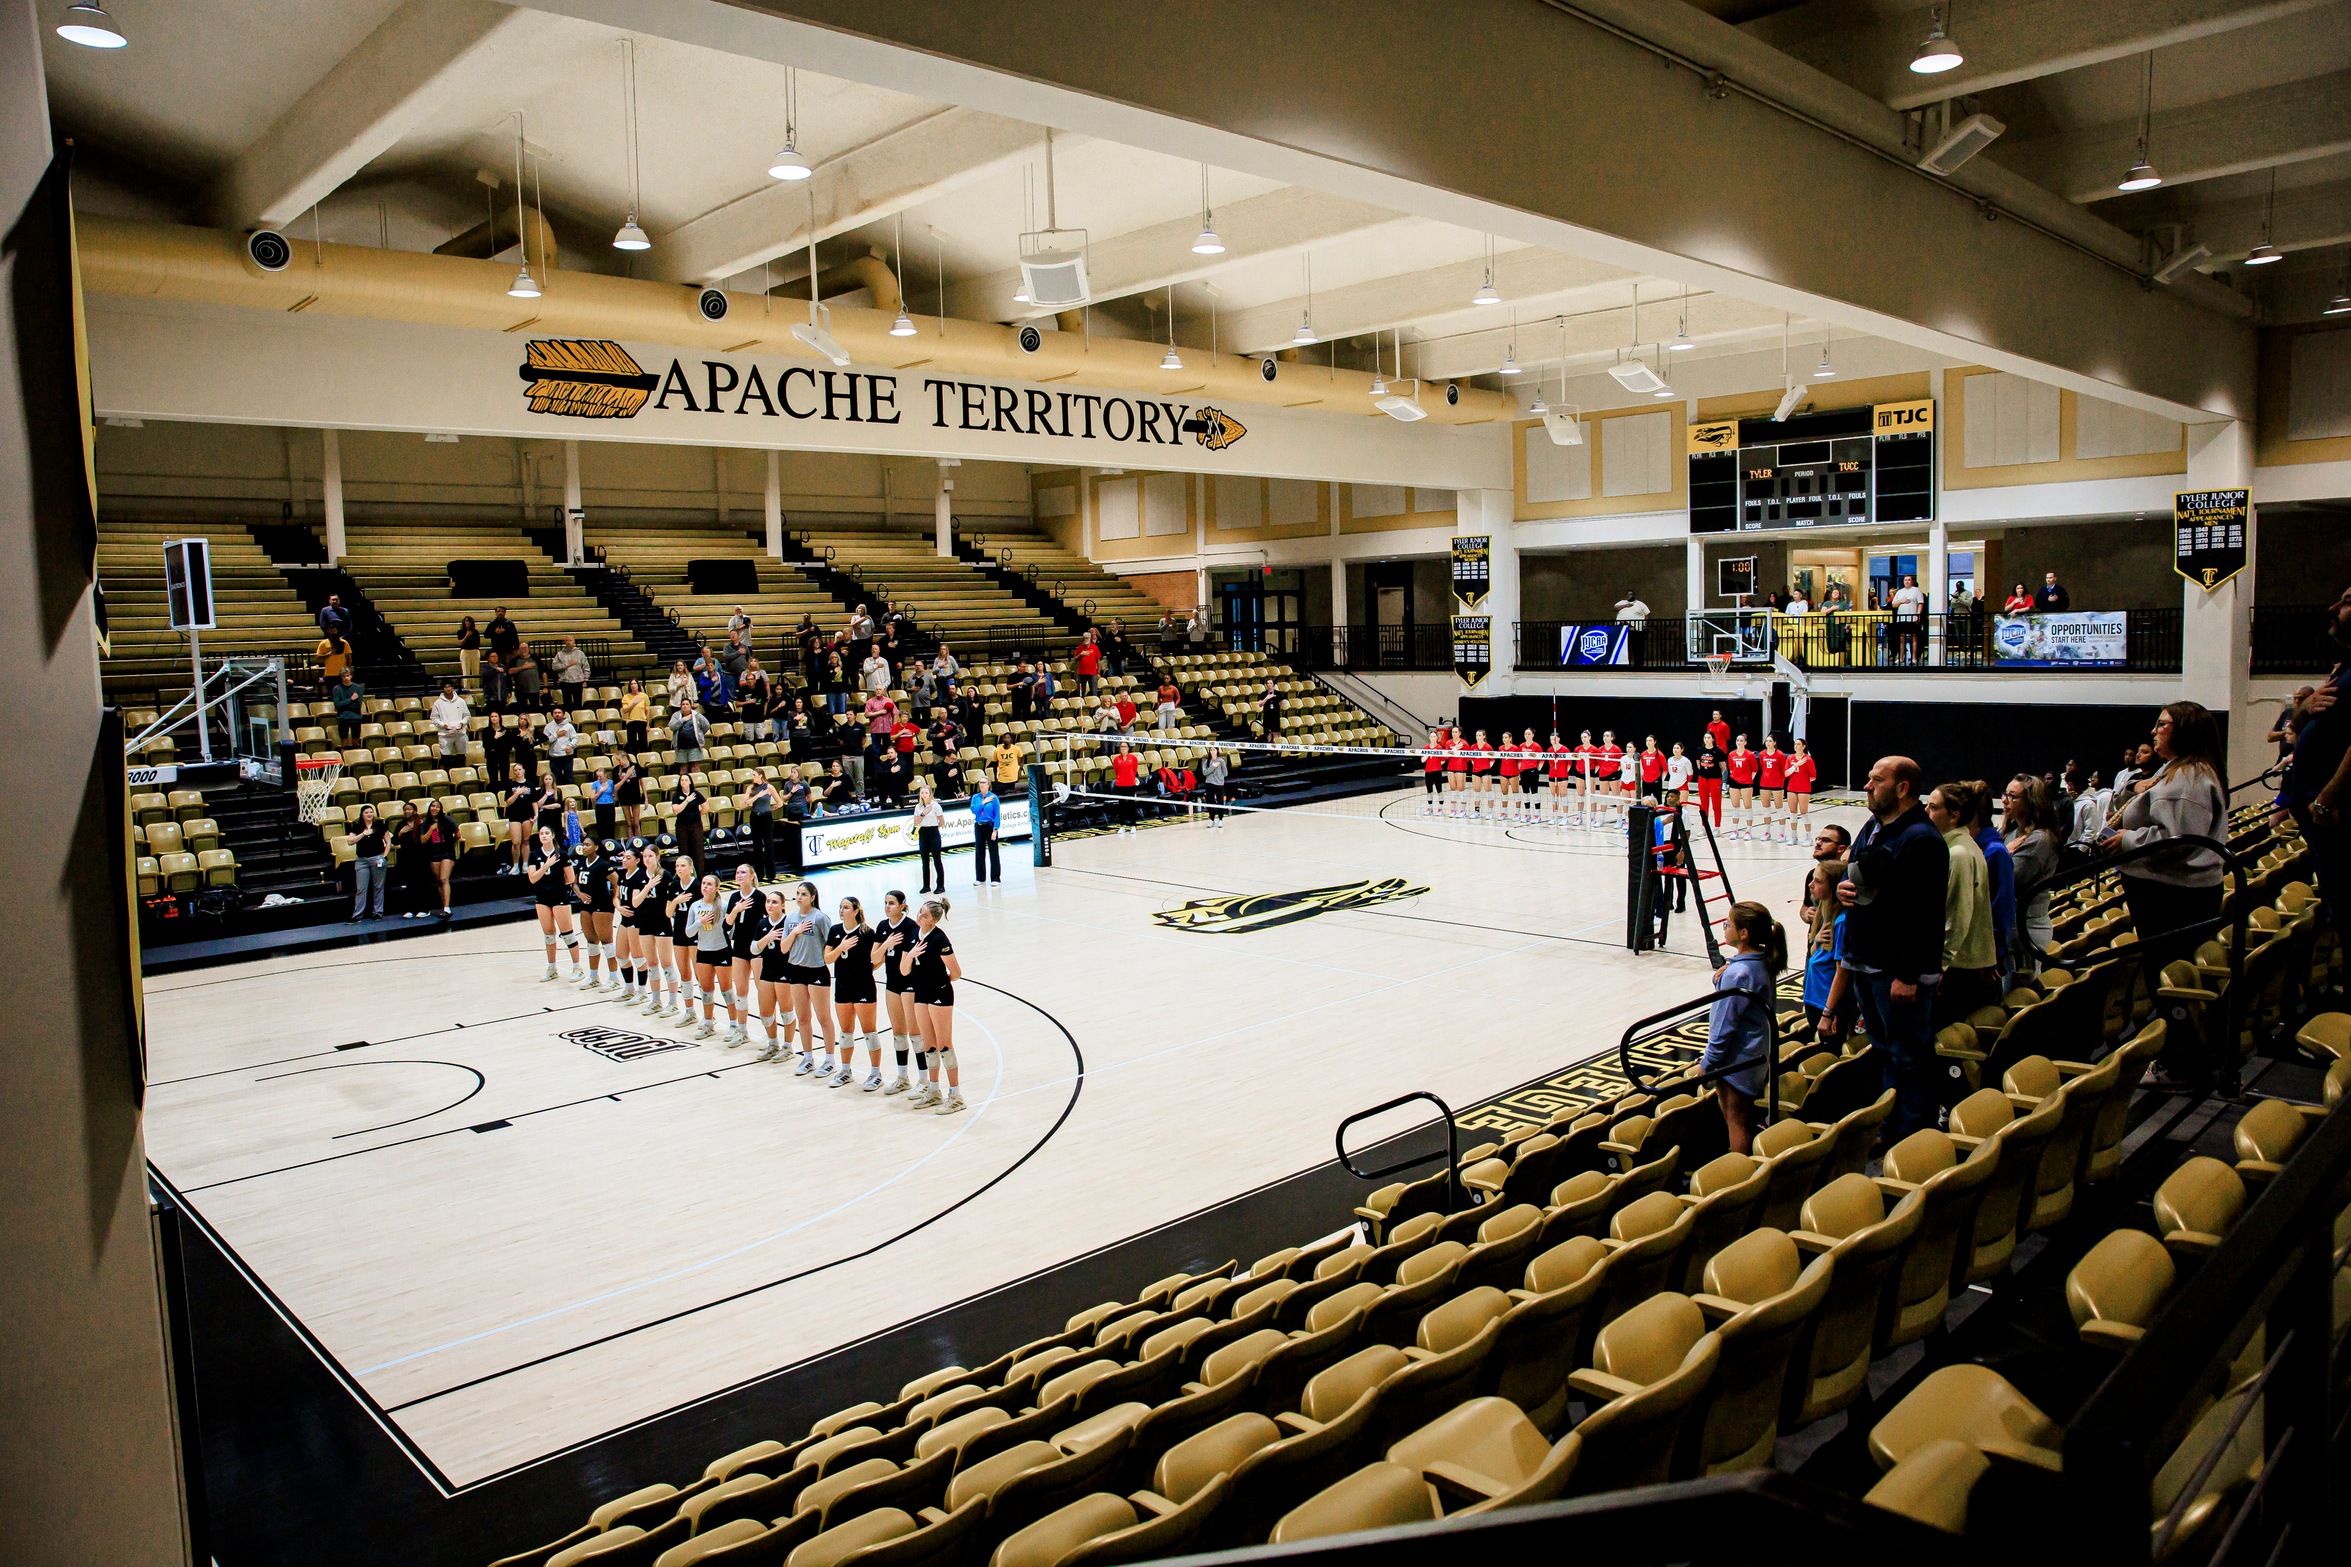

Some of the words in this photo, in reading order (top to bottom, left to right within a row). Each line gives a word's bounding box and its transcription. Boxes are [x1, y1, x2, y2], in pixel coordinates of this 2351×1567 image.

[653, 358, 901, 424] APACHE
[924, 378, 1190, 446] TERRITORY
[1893, 407, 1928, 425] TJC
[1749, 468, 1773, 479] TYLER
[1786, 496, 1806, 504] PLAYER
[1848, 492, 1867, 500] FOULS
[2180, 493, 2208, 503] TYLER
[2211, 490, 2245, 501] JUNIOR
[1745, 499, 1762, 507] FOULS
[2187, 499, 2237, 510] COLLEGE
[1796, 519, 1814, 527] MATCH
[1847, 516, 1866, 524] SCORE
[1745, 522, 1762, 530] SCORE
[1457, 542, 1483, 550] COLLEGE
[1732, 562, 1751, 573] 1:00
[1458, 622, 1485, 630] COLLEGE
[2051, 623, 2123, 636] OPPORTUNITIES
[2001, 627, 2027, 640] NJCAA
[1580, 635, 1608, 652] NJCAA
[2051, 636, 2070, 644] START
[2071, 635, 2087, 643] HERE
[826, 826, 875, 851] Wagstaff
[877, 823, 901, 839] Gym
[578, 871, 590, 884] 15
[619, 885, 628, 900] 14
[564, 1027, 692, 1061] NJCAA
